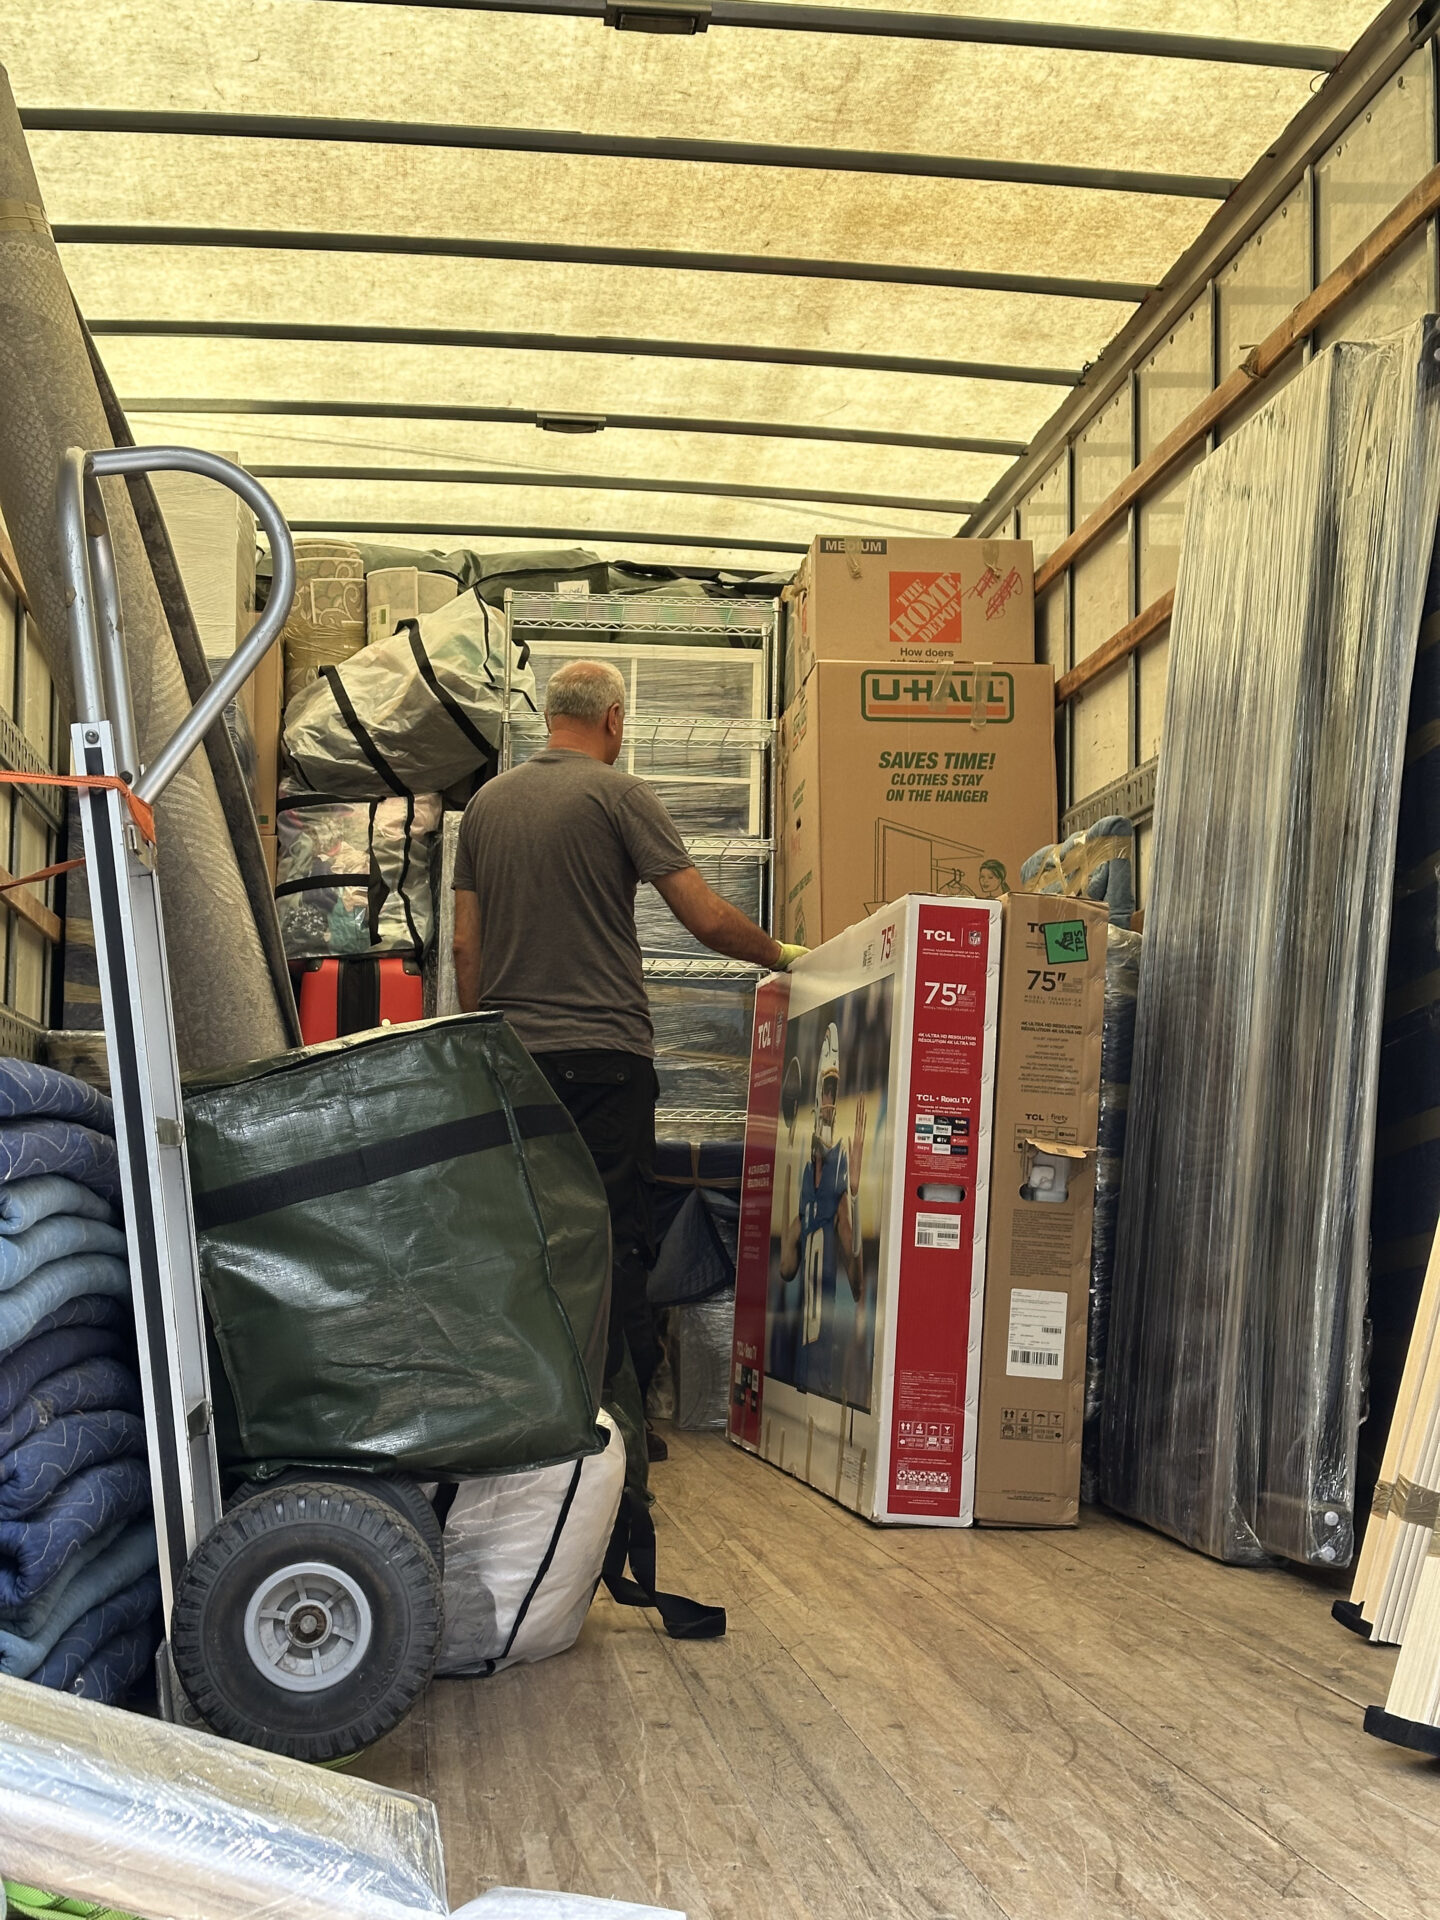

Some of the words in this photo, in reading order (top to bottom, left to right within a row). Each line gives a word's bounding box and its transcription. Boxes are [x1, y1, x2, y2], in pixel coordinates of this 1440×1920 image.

[896, 579, 928, 607] THE
[890, 572, 962, 642] HOME
[917, 598, 962, 642] DEPOT
[900, 647, 923, 656] How
[925, 648, 954, 657] doers
[878, 751, 939, 770] SAVES
[944, 752, 996, 770] TIME!
[891, 773, 948, 786] CLOTHES
[951, 774, 984, 786] STAY
[886, 789, 904, 801] ON
[908, 790, 932, 802] THE
[935, 790, 988, 802] HANGER
[923, 929, 955, 942] TCL
[1073, 930, 1085, 952] TPS
[1027, 969, 1067, 991] 75"
[924, 981, 967, 1006] 75"
[758, 1020, 772, 1049] TCL
[916, 1093, 935, 1102] TCL
[1025, 1113, 1044, 1121] TCL
